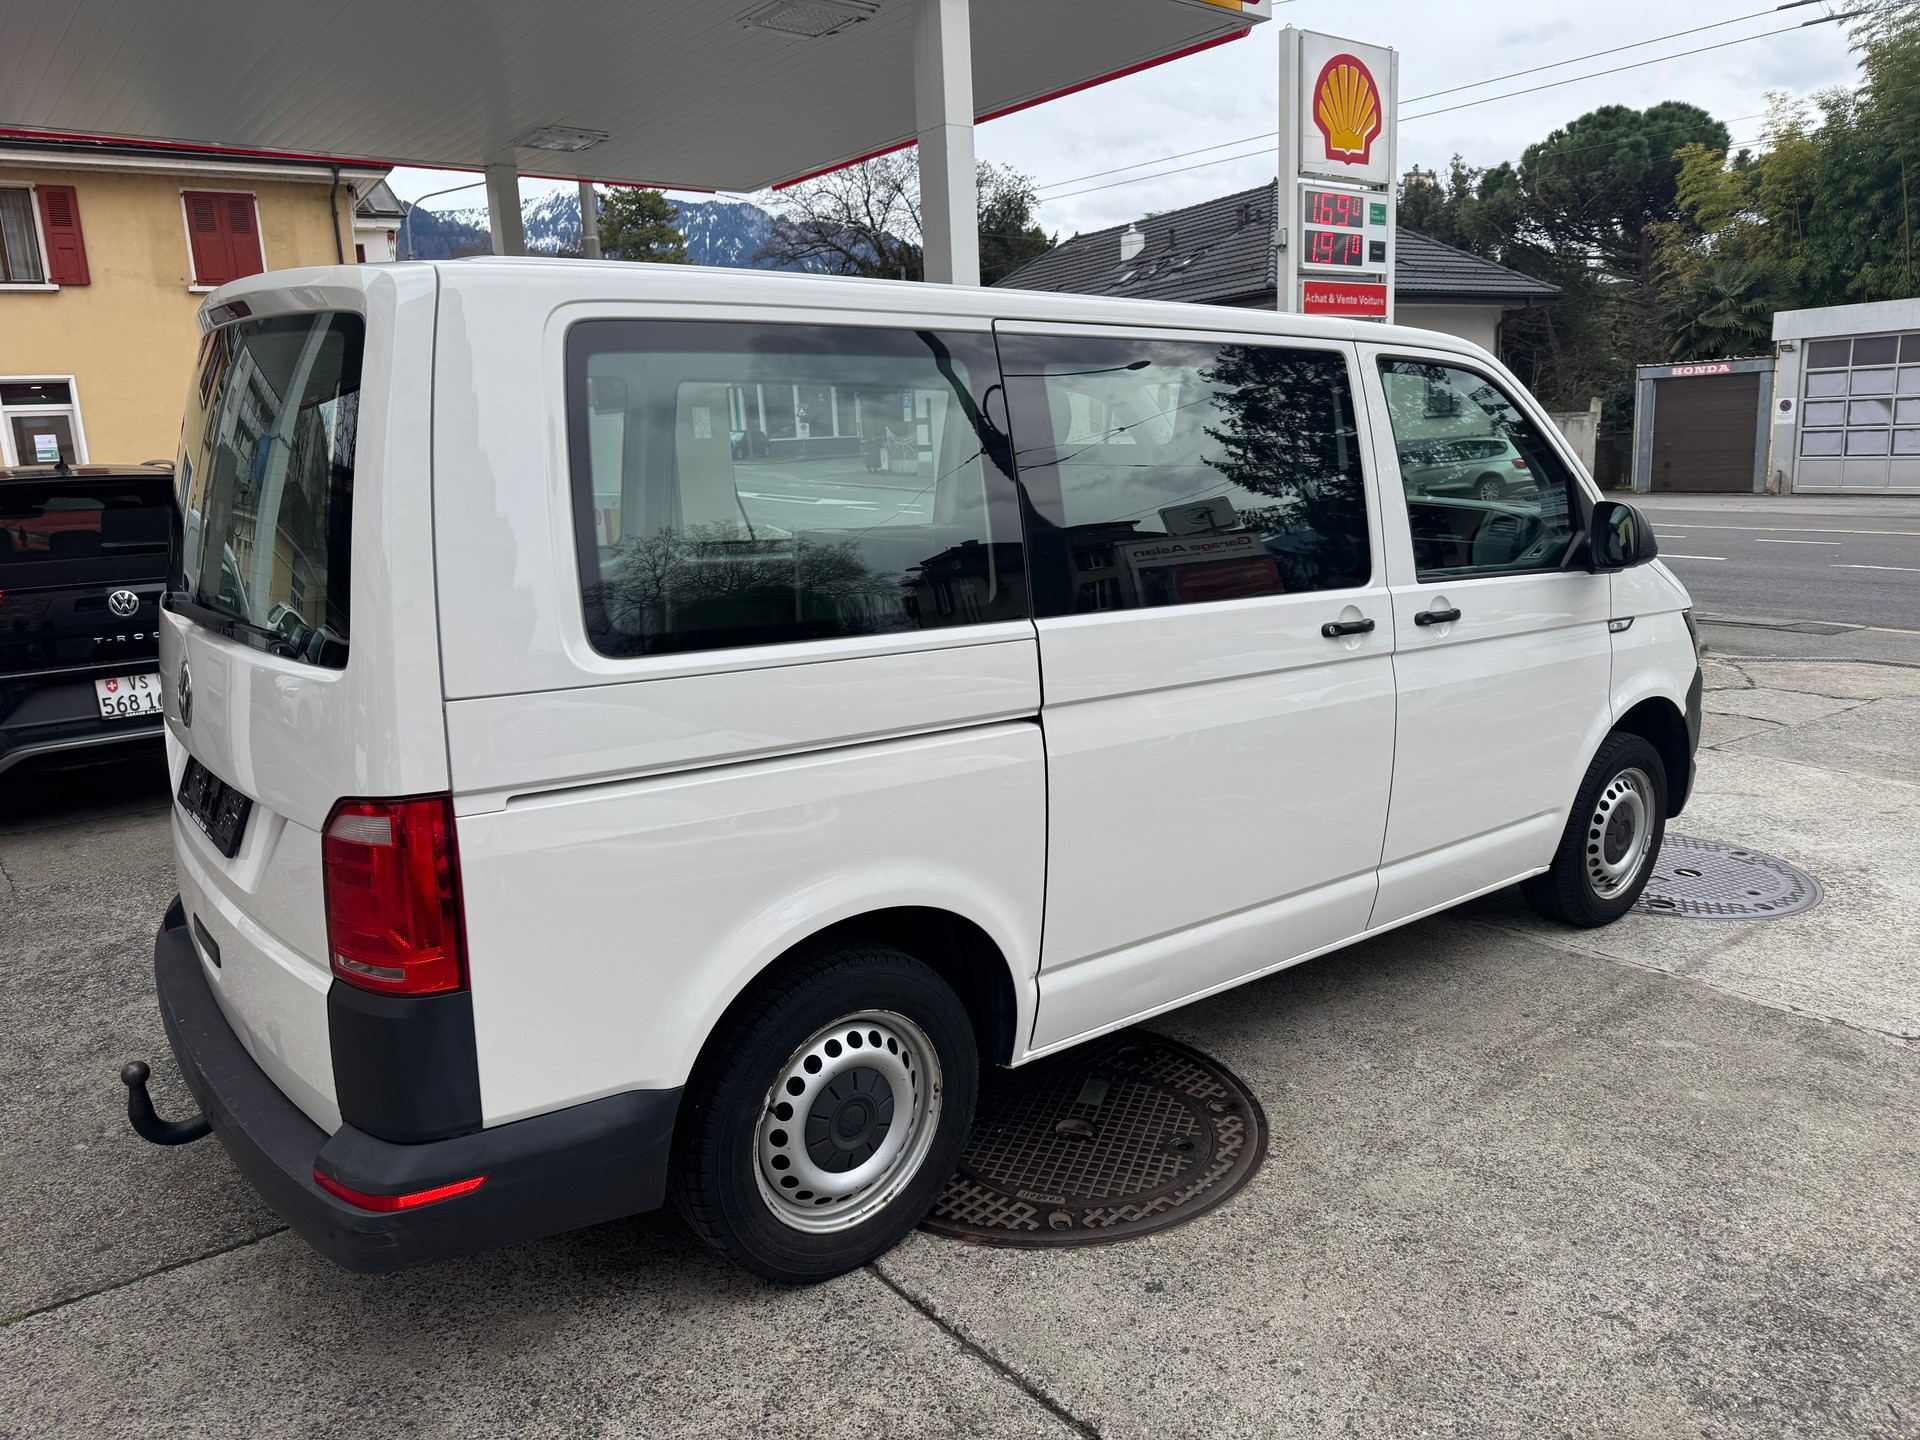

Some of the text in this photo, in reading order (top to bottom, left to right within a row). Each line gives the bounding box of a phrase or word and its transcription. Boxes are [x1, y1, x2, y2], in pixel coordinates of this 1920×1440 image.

[1305, 292, 1385, 306] Achat & Vente Voiture
[1671, 364, 1730, 376] HONDA
[127, 675, 149, 691] VS
[102, 694, 141, 715] 568
